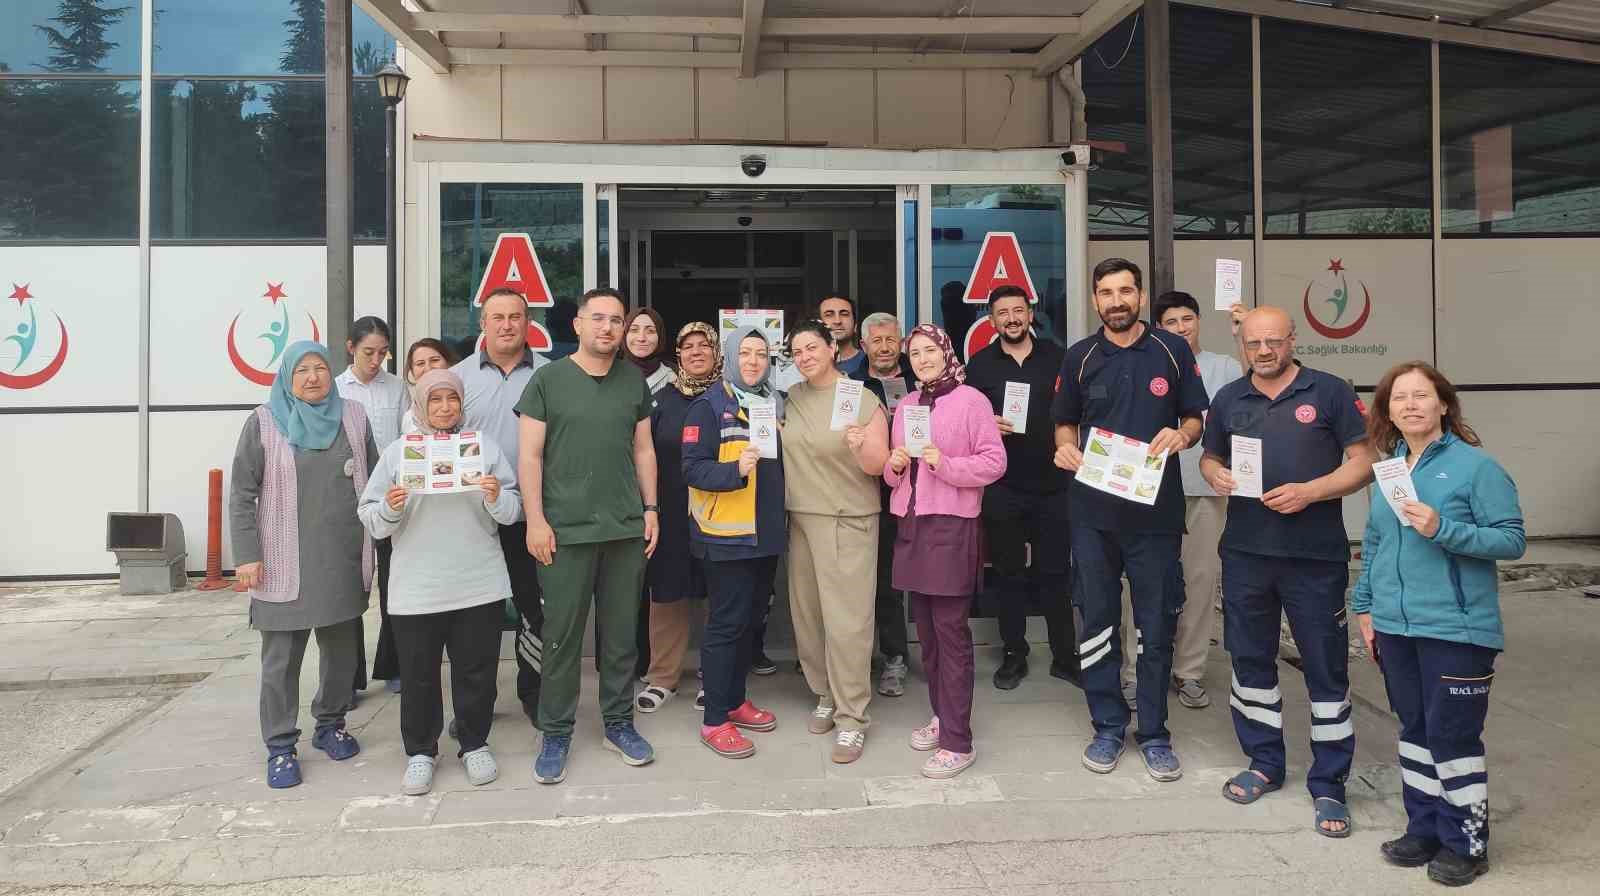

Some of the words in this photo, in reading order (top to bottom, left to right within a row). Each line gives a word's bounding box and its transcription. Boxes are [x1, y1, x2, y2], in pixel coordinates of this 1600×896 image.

[473, 232, 554, 352] A
[1308, 344, 1338, 356] Sağlık
[1341, 343, 1388, 356] Bakanlığı
